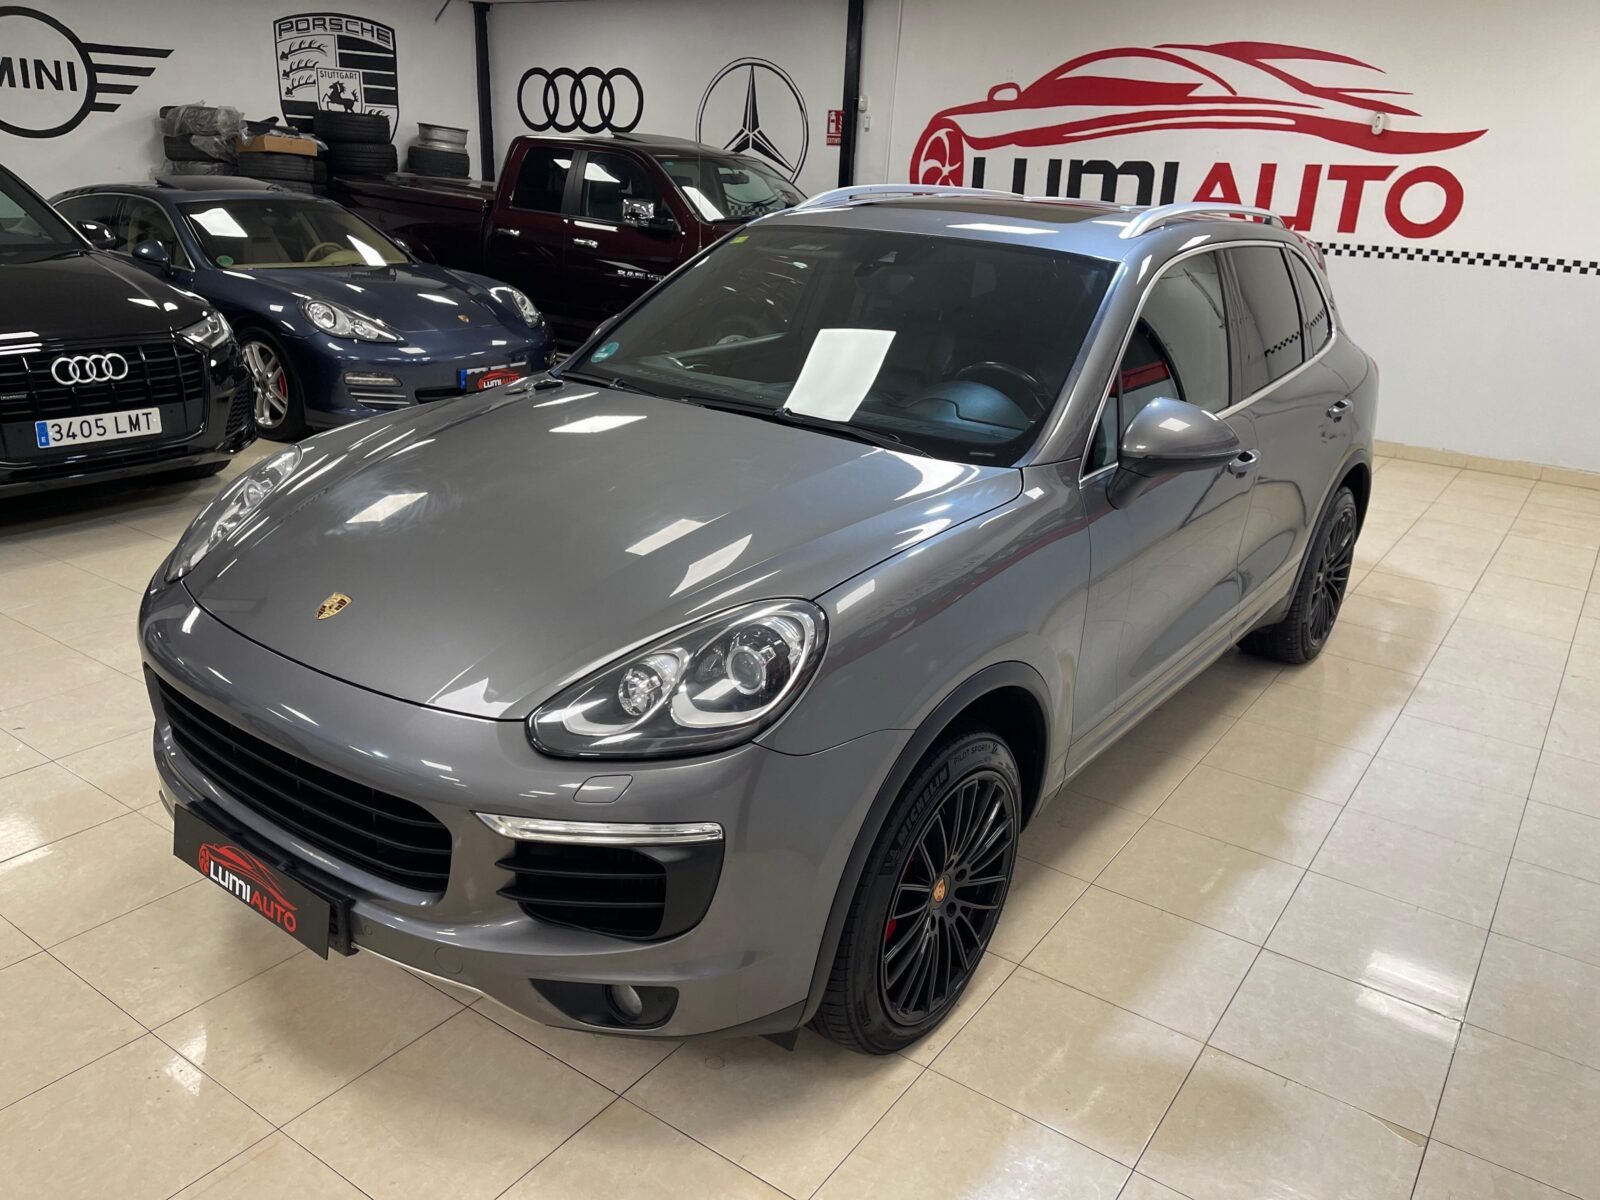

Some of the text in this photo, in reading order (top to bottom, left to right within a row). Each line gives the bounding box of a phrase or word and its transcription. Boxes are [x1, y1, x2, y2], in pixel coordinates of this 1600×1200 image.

[278, 17, 391, 48] PORSCHE
[319, 70, 357, 81] STUTTGART
[51, 412, 152, 442] 3405 LMT
[896, 767, 948, 847] MICHELIN
[209, 860, 297, 932] LUMIAUTO
